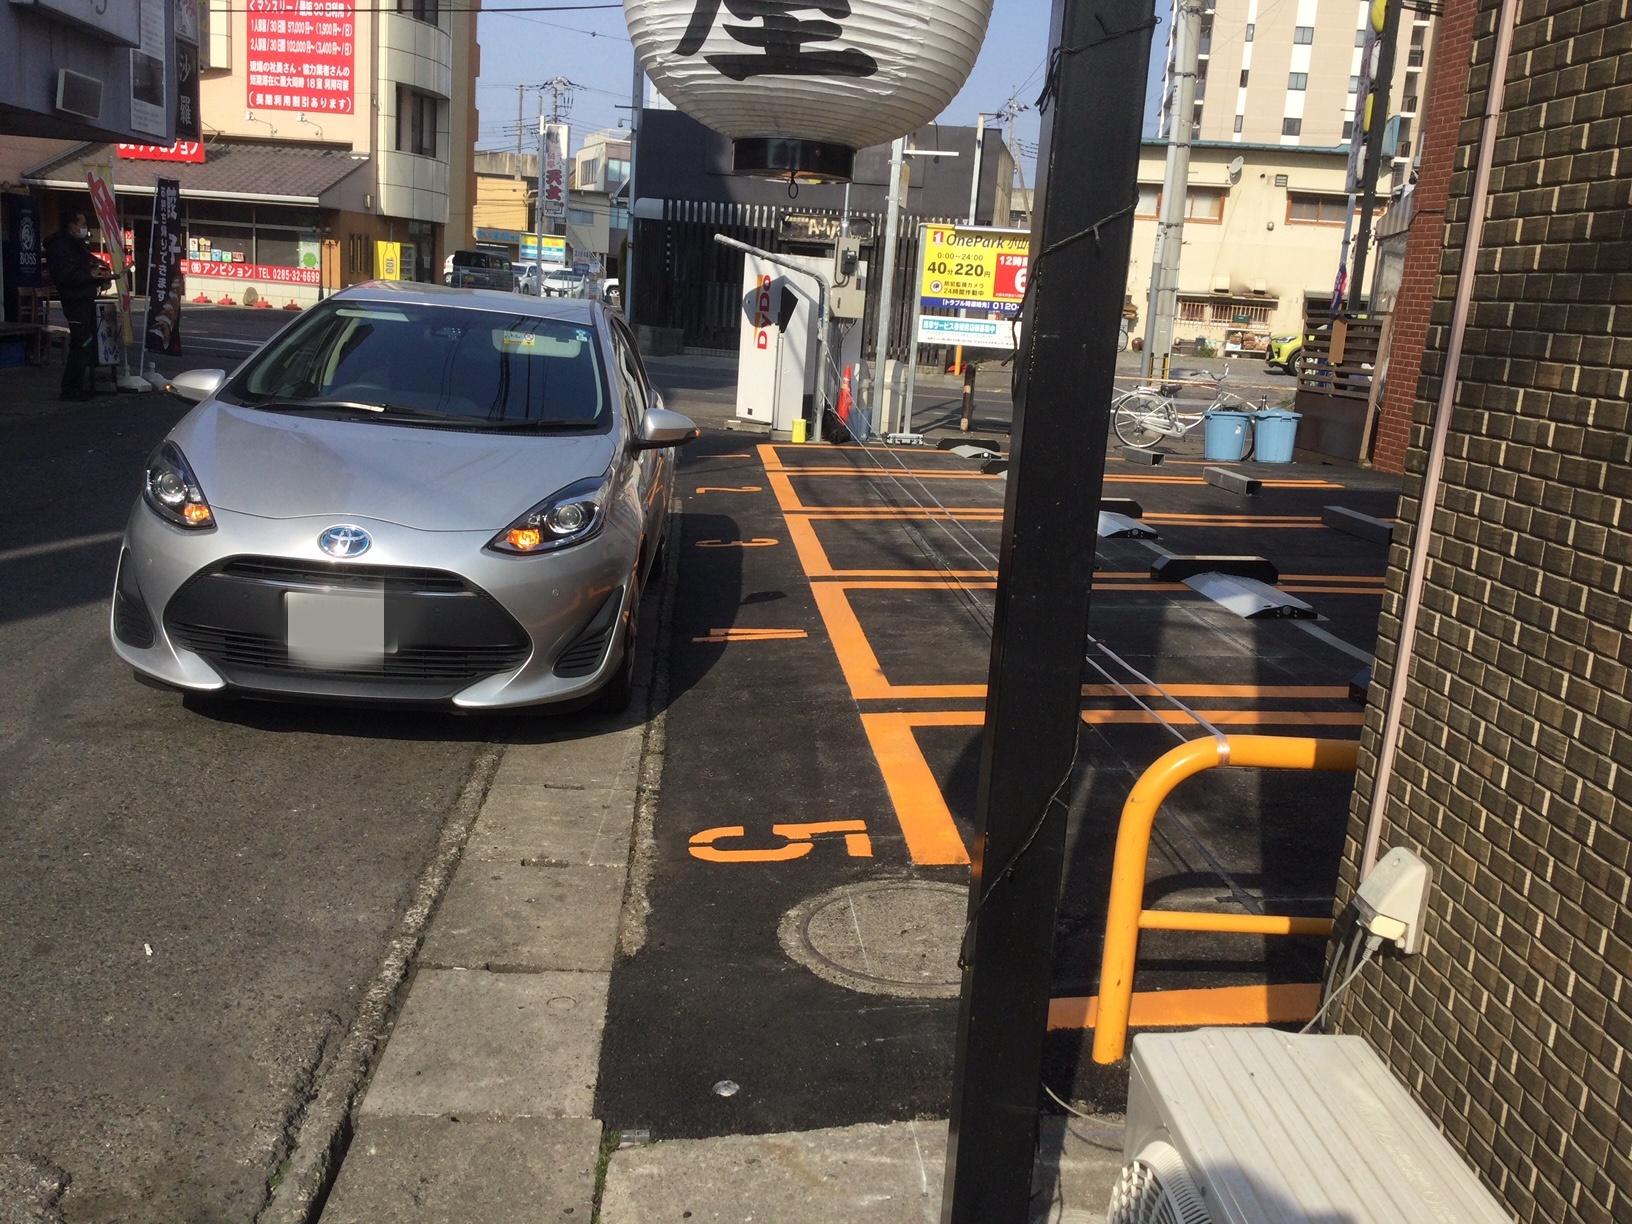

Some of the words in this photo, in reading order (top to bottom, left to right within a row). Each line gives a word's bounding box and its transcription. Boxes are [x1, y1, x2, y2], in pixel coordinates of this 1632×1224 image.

[946, 232, 1004, 249] OnePark
[259, 267, 270, 279] TEL
[688, 819, 873, 863] 5
